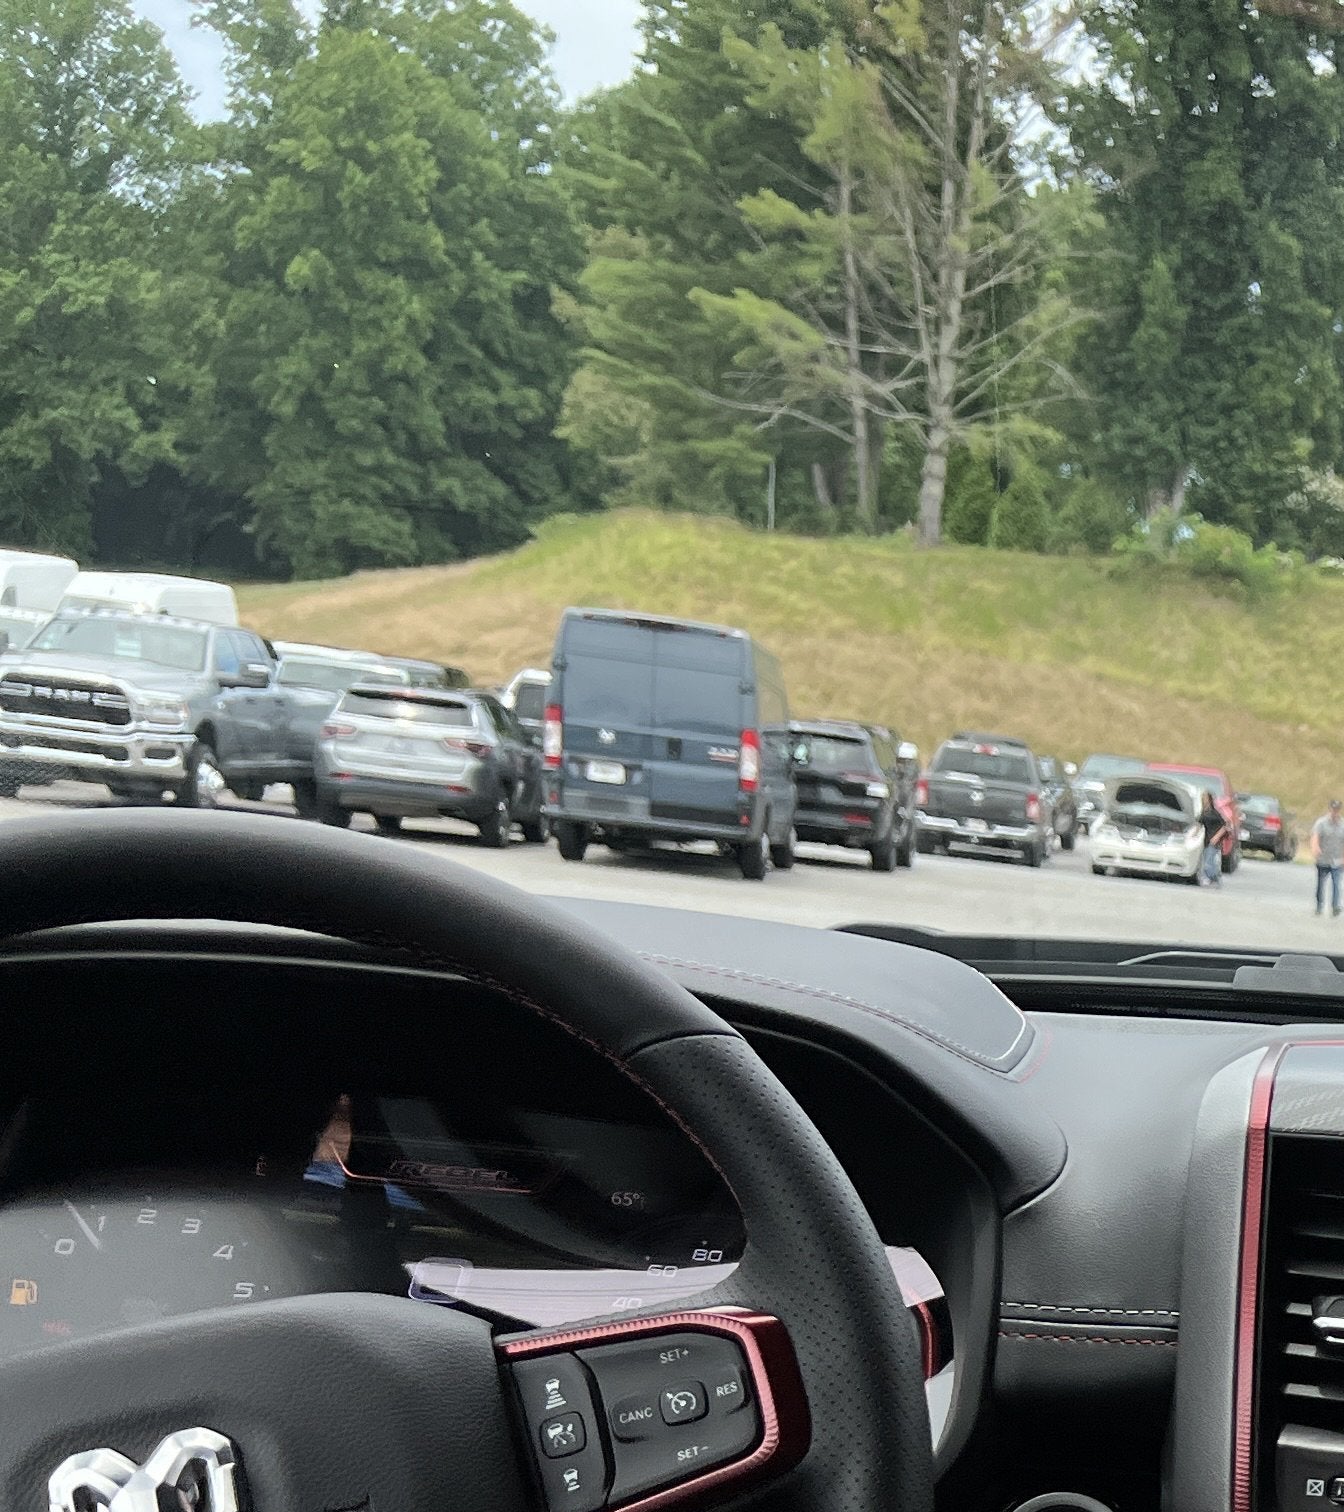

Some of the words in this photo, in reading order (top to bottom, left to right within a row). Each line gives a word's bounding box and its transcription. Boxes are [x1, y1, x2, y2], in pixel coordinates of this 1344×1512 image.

[98, 1215, 106, 1233] 1
[137, 1208, 157, 1225] 2
[181, 1217, 202, 1234] 3
[212, 1243, 235, 1260] 4
[692, 1248, 723, 1263] 80
[647, 1263, 679, 1278] 60
[233, 1281, 256, 1298] 5
[612, 1296, 642, 1310] 40
[716, 1380, 738, 1397] RES
[619, 1406, 653, 1424] CANC
